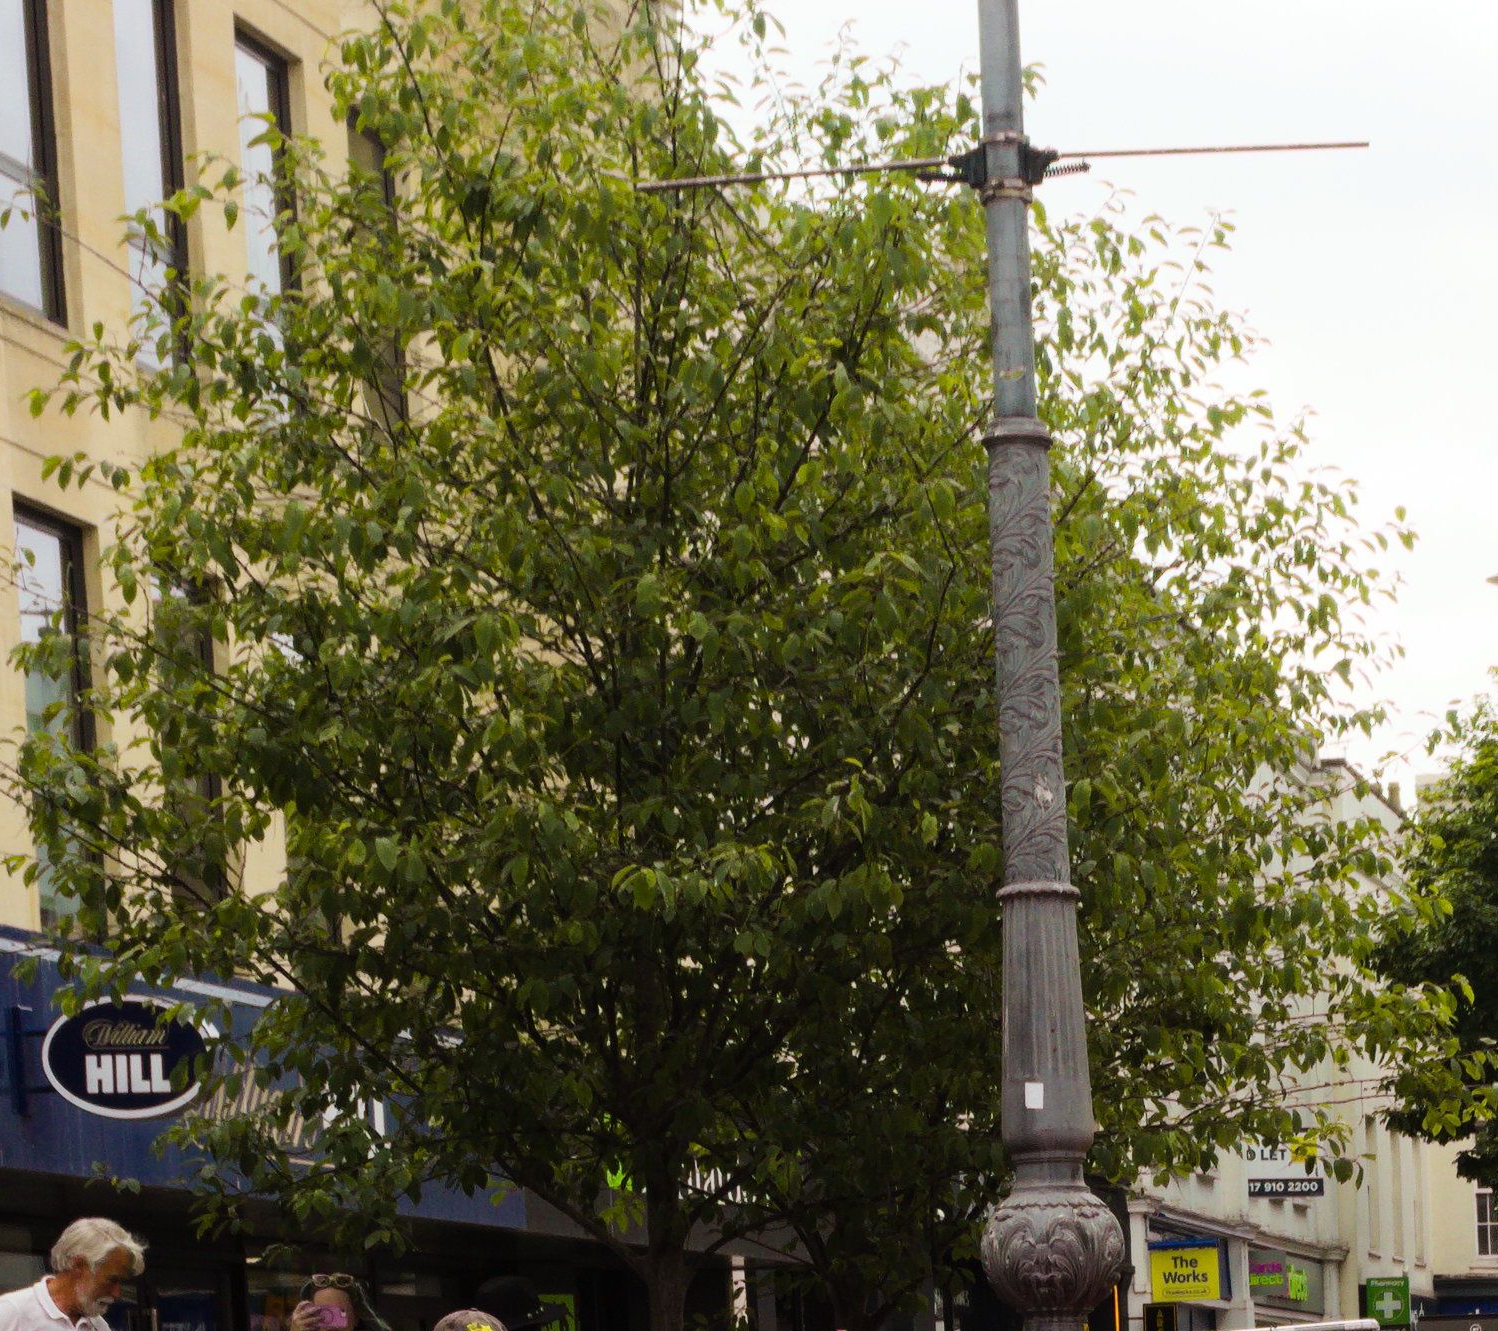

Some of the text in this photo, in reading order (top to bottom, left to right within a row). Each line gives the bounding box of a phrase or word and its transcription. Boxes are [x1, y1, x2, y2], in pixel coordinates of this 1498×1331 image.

[82, 1020, 169, 1049] William
[85, 1053, 171, 1095] HILL
[1260, 1150, 1287, 1161] LET
[1249, 1180, 1319, 1193] 17 910 2200
[1171, 1256, 1198, 1269] The
[1162, 1270, 1209, 1284] Works
